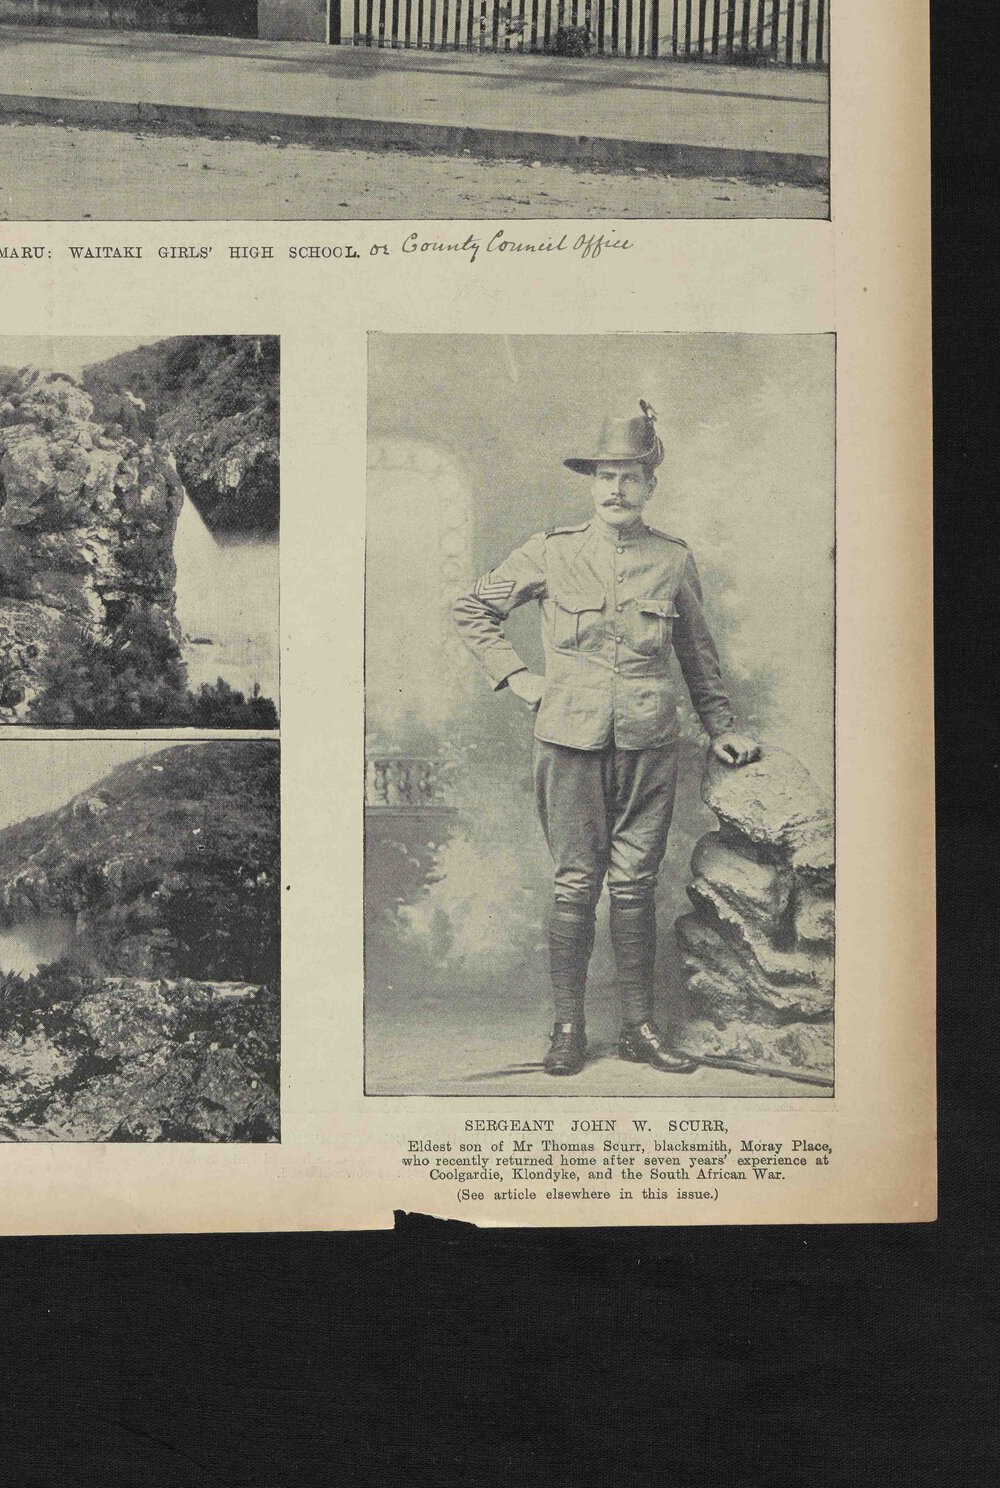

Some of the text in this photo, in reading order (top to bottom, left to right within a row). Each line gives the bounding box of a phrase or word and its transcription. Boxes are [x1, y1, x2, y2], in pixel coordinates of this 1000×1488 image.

[67, 246, 143, 260] WAITAKI
[228, 245, 275, 260] HIGH
[288, 245, 361, 260] SCHOOL.
[401, 232, 481, 263] County
[486, 229, 568, 253] Council
[572, 229, 636, 259] Office
[464, 1119, 729, 1135] SERGEANT JOHN W. SCURR,
[407, 1140, 833, 1156] Eldest son of Mr Thomas Scurr, blacksmith, Moray Place,
[401, 1155, 430, 1167] who
[435, 1155, 490, 1170] recently
[495, 1155, 554, 1168] returned
[559, 1155, 597, 1167] home
[602, 1155, 636, 1167] after
[643, 1157, 680, 1167] seven
[737, 1155, 808, 1170] experience
[815, 1156, 830, 1167] at
[429, 1168, 786, 1183] Coolgardie, Klondyke, and the South African War.
[456, 1187, 719, 1203] (See article elsewhere in this issue.)
